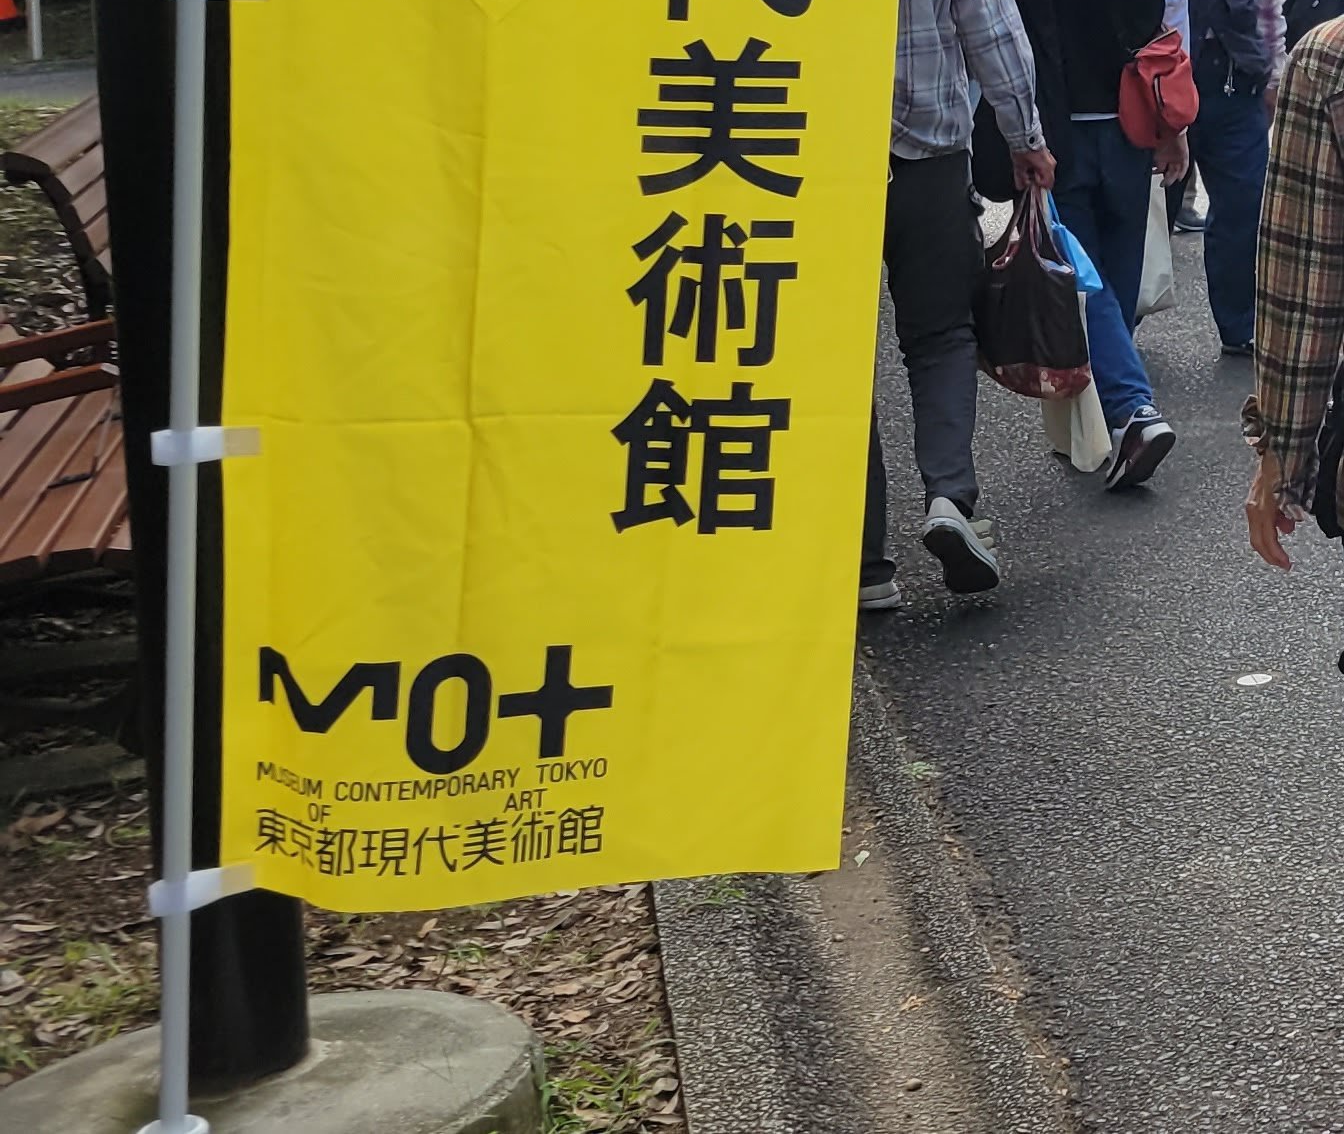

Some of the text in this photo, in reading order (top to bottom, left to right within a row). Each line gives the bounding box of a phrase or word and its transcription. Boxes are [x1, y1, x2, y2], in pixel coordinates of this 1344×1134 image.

[256, 757, 608, 802] MUSEUM CONTEMPORARY TOKYO
[307, 803, 332, 824] OF
[503, 788, 549, 813] ART
[255, 805, 604, 877] 東京都現代美術館
